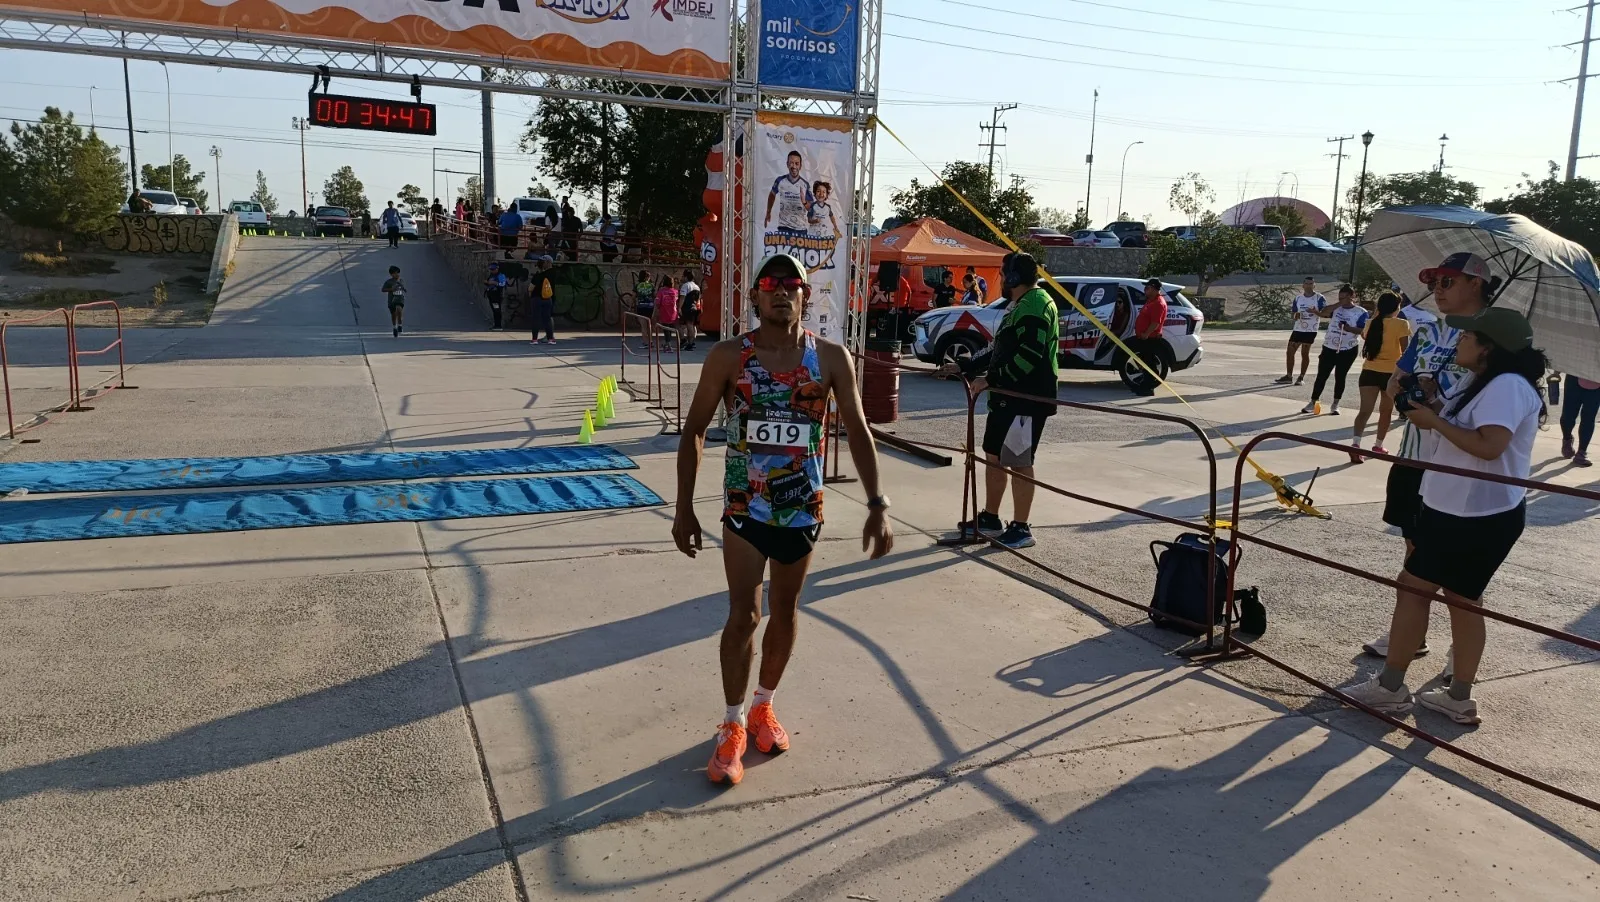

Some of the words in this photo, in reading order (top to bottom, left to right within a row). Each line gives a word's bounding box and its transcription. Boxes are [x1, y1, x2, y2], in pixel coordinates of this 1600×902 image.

[766, 17, 792, 34] mil
[766, 35, 836, 55] sonrisas
[780, 54, 822, 62] PROGRAMA
[316, 99, 349, 123] 00
[765, 235, 787, 246] UNA
[789, 236, 836, 251] SONRISA
[756, 423, 800, 444] 619
